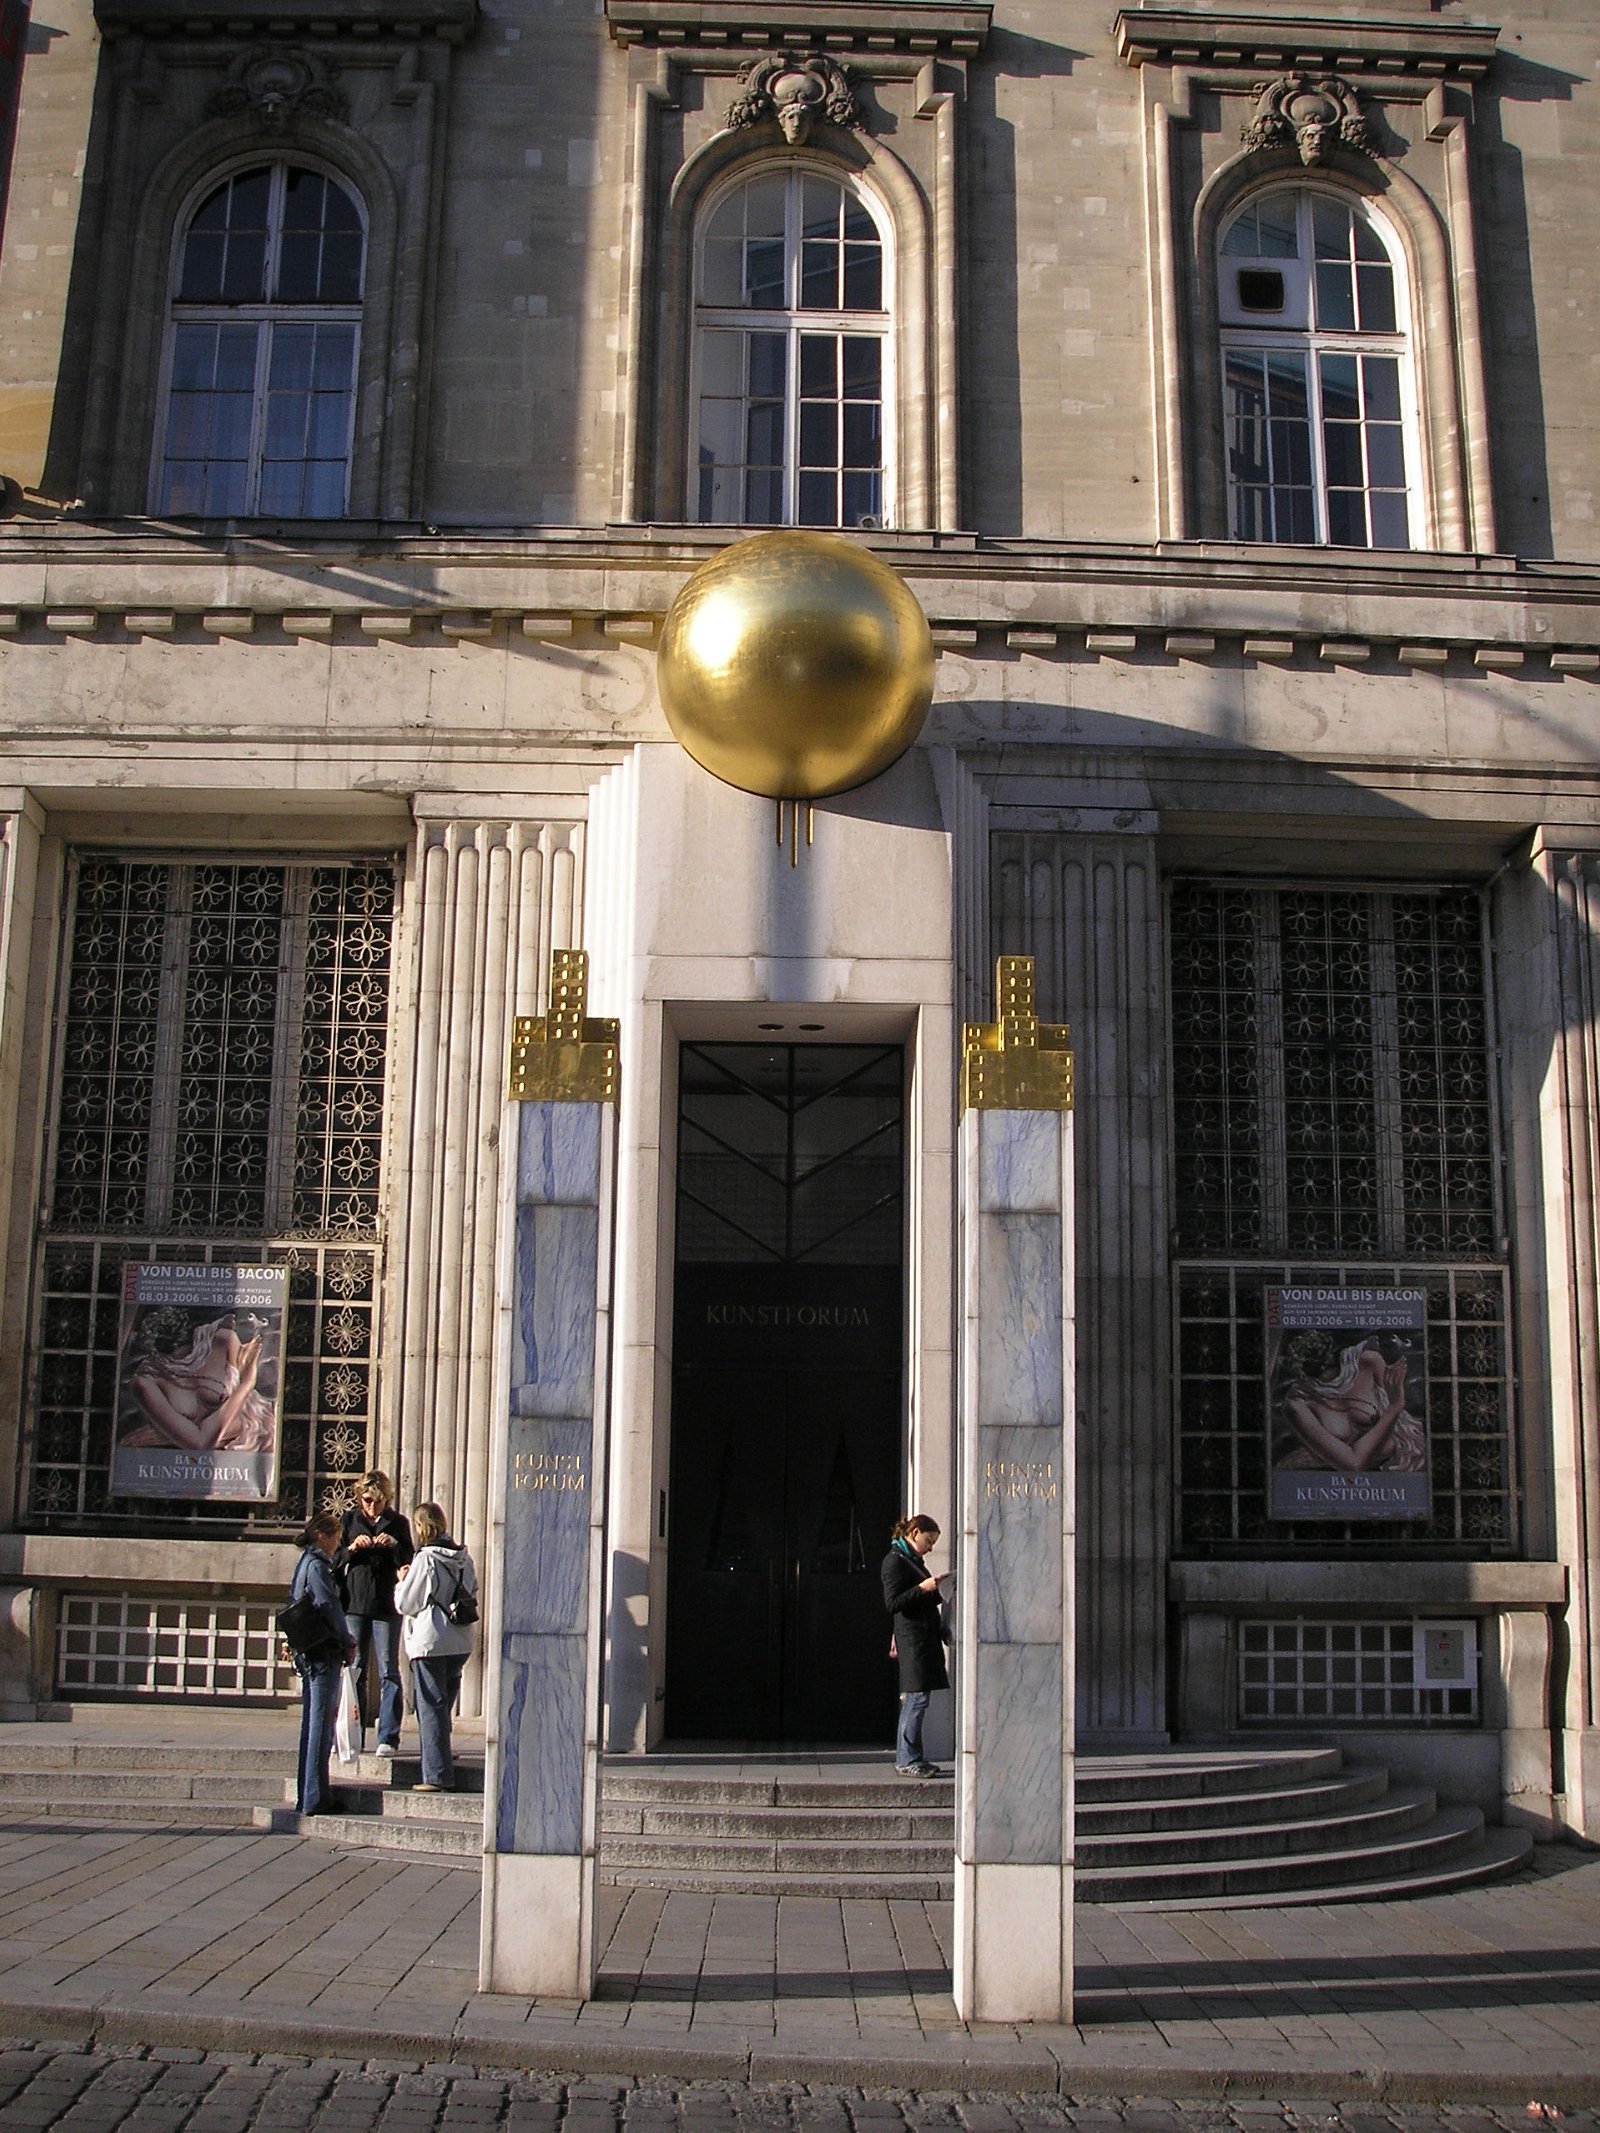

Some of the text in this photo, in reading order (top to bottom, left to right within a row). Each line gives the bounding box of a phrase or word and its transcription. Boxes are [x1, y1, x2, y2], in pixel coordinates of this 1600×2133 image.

[141, 1265, 285, 1280] VON DALI BIS BACON
[139, 1292, 200, 1302] 08.03.2006
[212, 1294, 272, 1305] 18.06.2006
[1282, 1289, 1423, 1302] VON DALI BIS BACON
[706, 1304, 869, 1326] KUNSTFORUM
[1283, 1316, 1343, 1326] 08.03.2006
[1355, 1316, 1413, 1326] 18.06.2006
[513, 1453, 585, 1471] KUNST
[139, 1464, 249, 1481] KUNSTFORUM
[985, 1462, 1056, 1480] KUNST
[512, 1472, 586, 1491] FORUM
[985, 1481, 1058, 1499] FORUM
[1297, 1487, 1406, 1501] KUNSTFORUM
